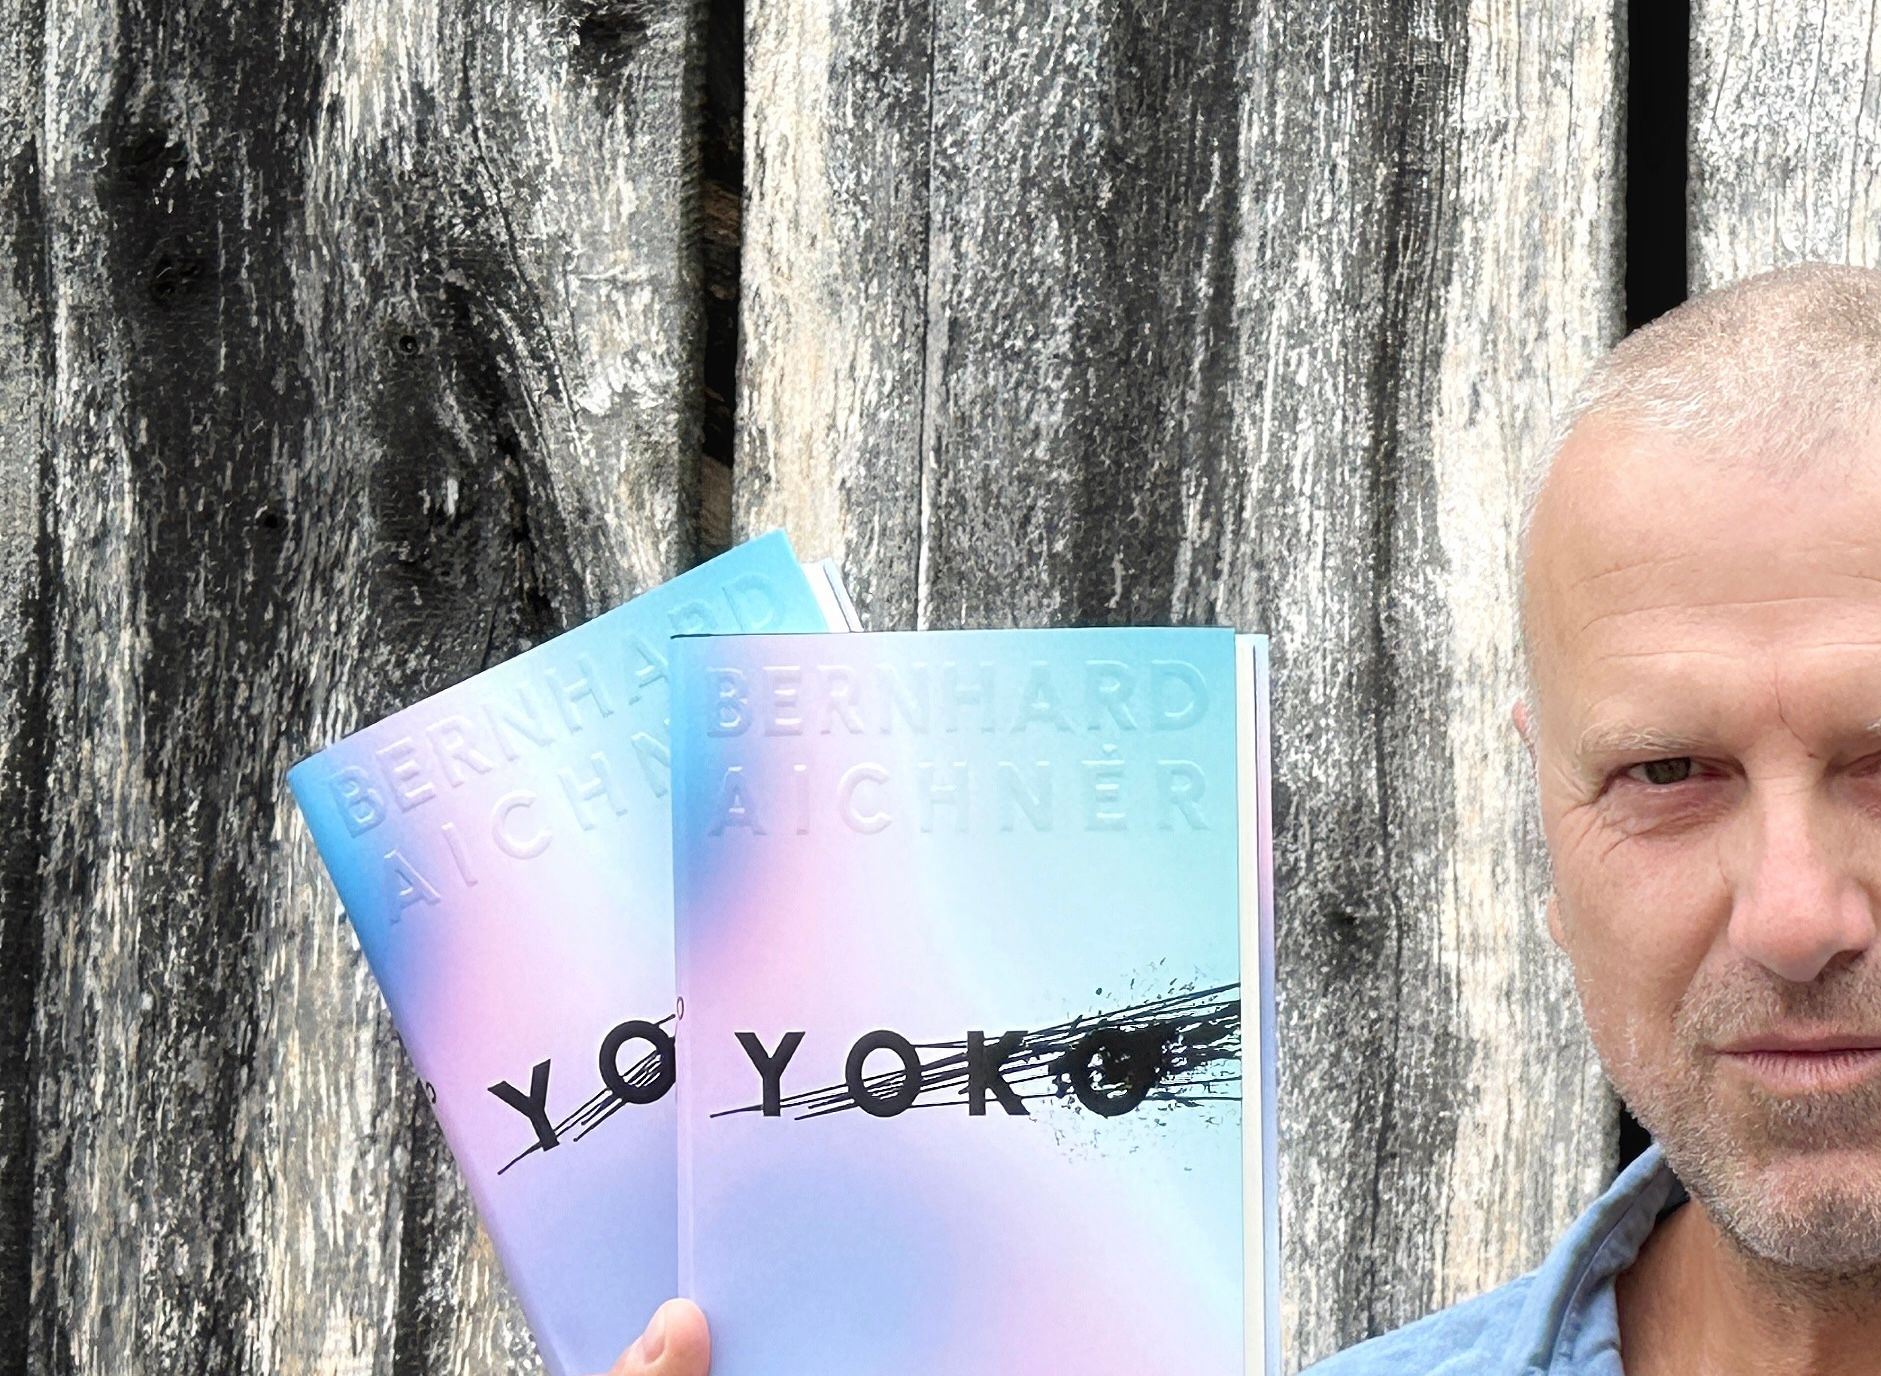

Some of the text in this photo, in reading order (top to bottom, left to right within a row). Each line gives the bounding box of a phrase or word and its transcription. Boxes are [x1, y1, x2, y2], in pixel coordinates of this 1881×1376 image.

[706, 658, 1211, 737] BERNHARD
[706, 758, 1212, 837] AICHNER
[734, 1028, 1155, 1117] YOKO
